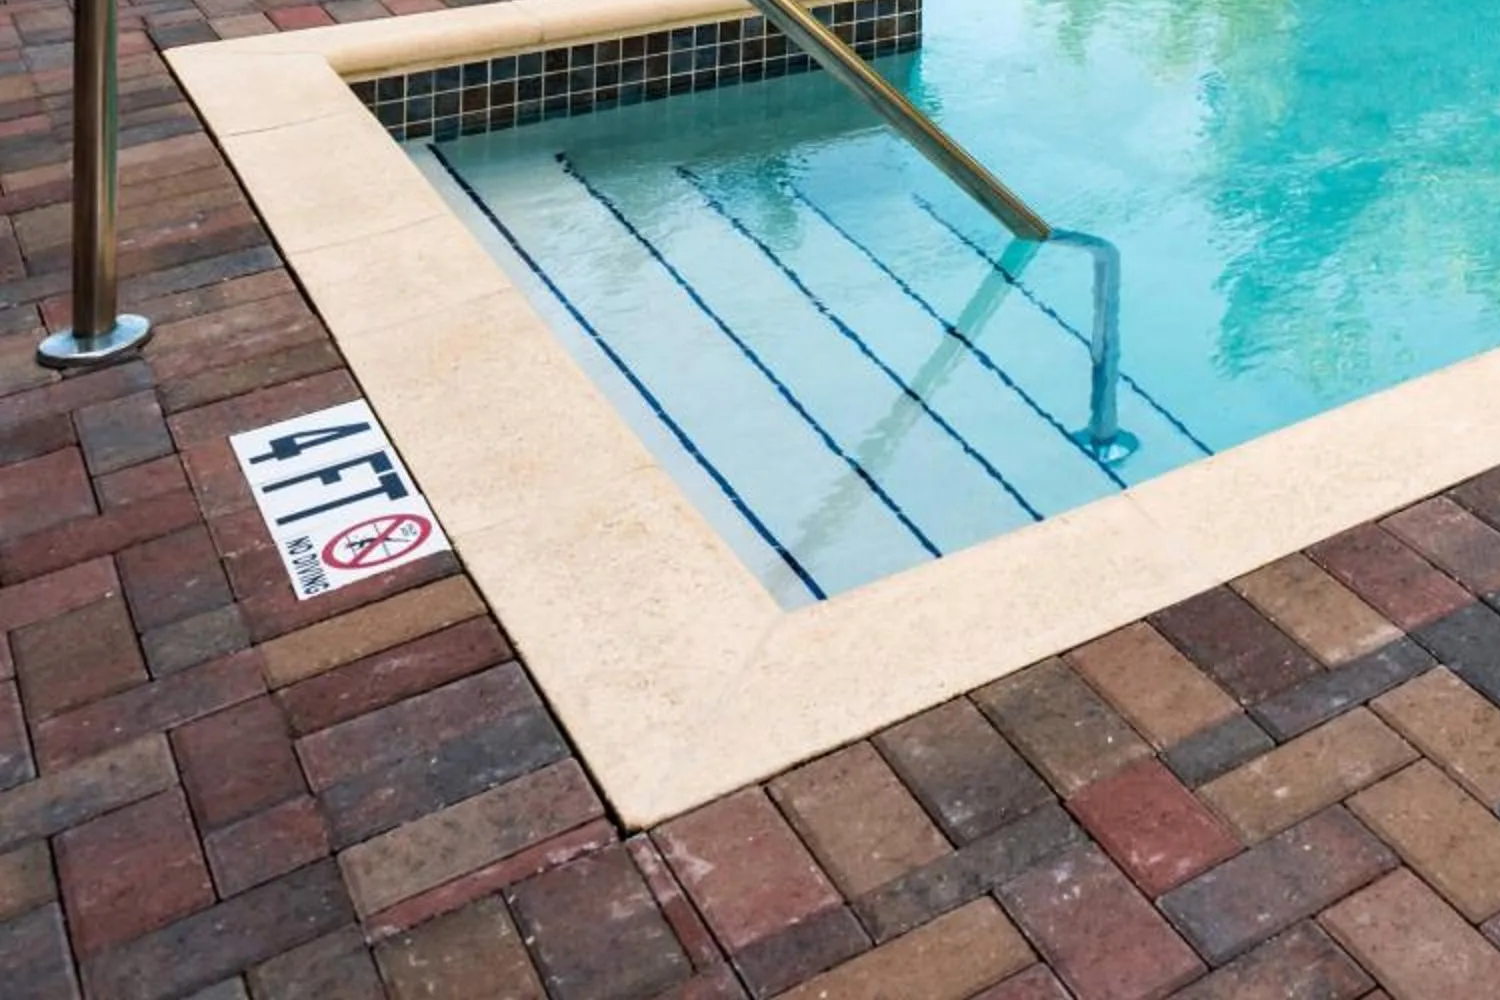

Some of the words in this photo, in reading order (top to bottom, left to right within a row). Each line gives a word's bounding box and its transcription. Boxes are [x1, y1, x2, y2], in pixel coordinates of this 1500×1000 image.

[249, 422, 371, 465] 4
[262, 450, 409, 526] FT
[285, 535, 313, 555] NO
[293, 553, 330, 595] DIVING
